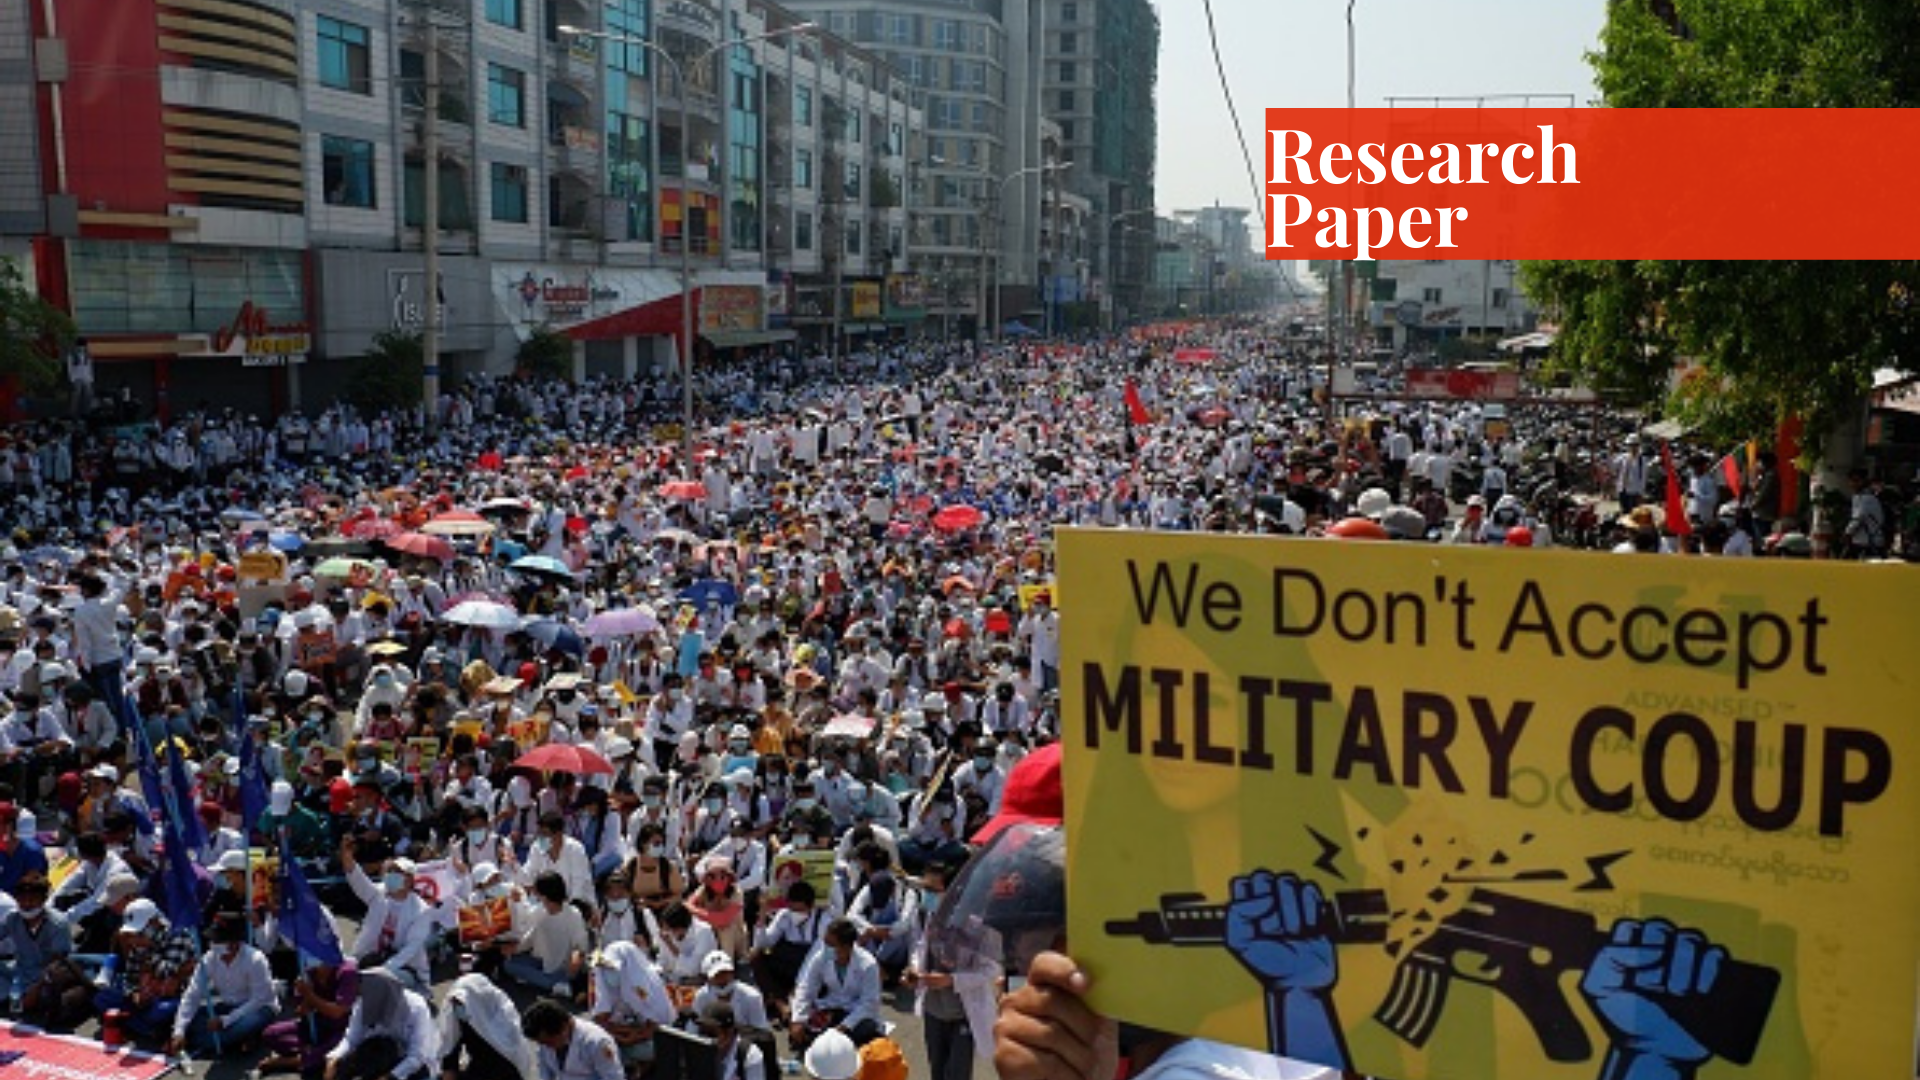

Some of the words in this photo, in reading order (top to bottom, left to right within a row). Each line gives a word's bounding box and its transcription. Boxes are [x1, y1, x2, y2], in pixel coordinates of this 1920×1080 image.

[1128, 559, 1242, 633] We
[1273, 569, 1476, 651] Don't
[1498, 581, 1828, 689] Accept
[1083, 662, 1536, 799] MILITARY
[1570, 706, 1893, 838] COUP
